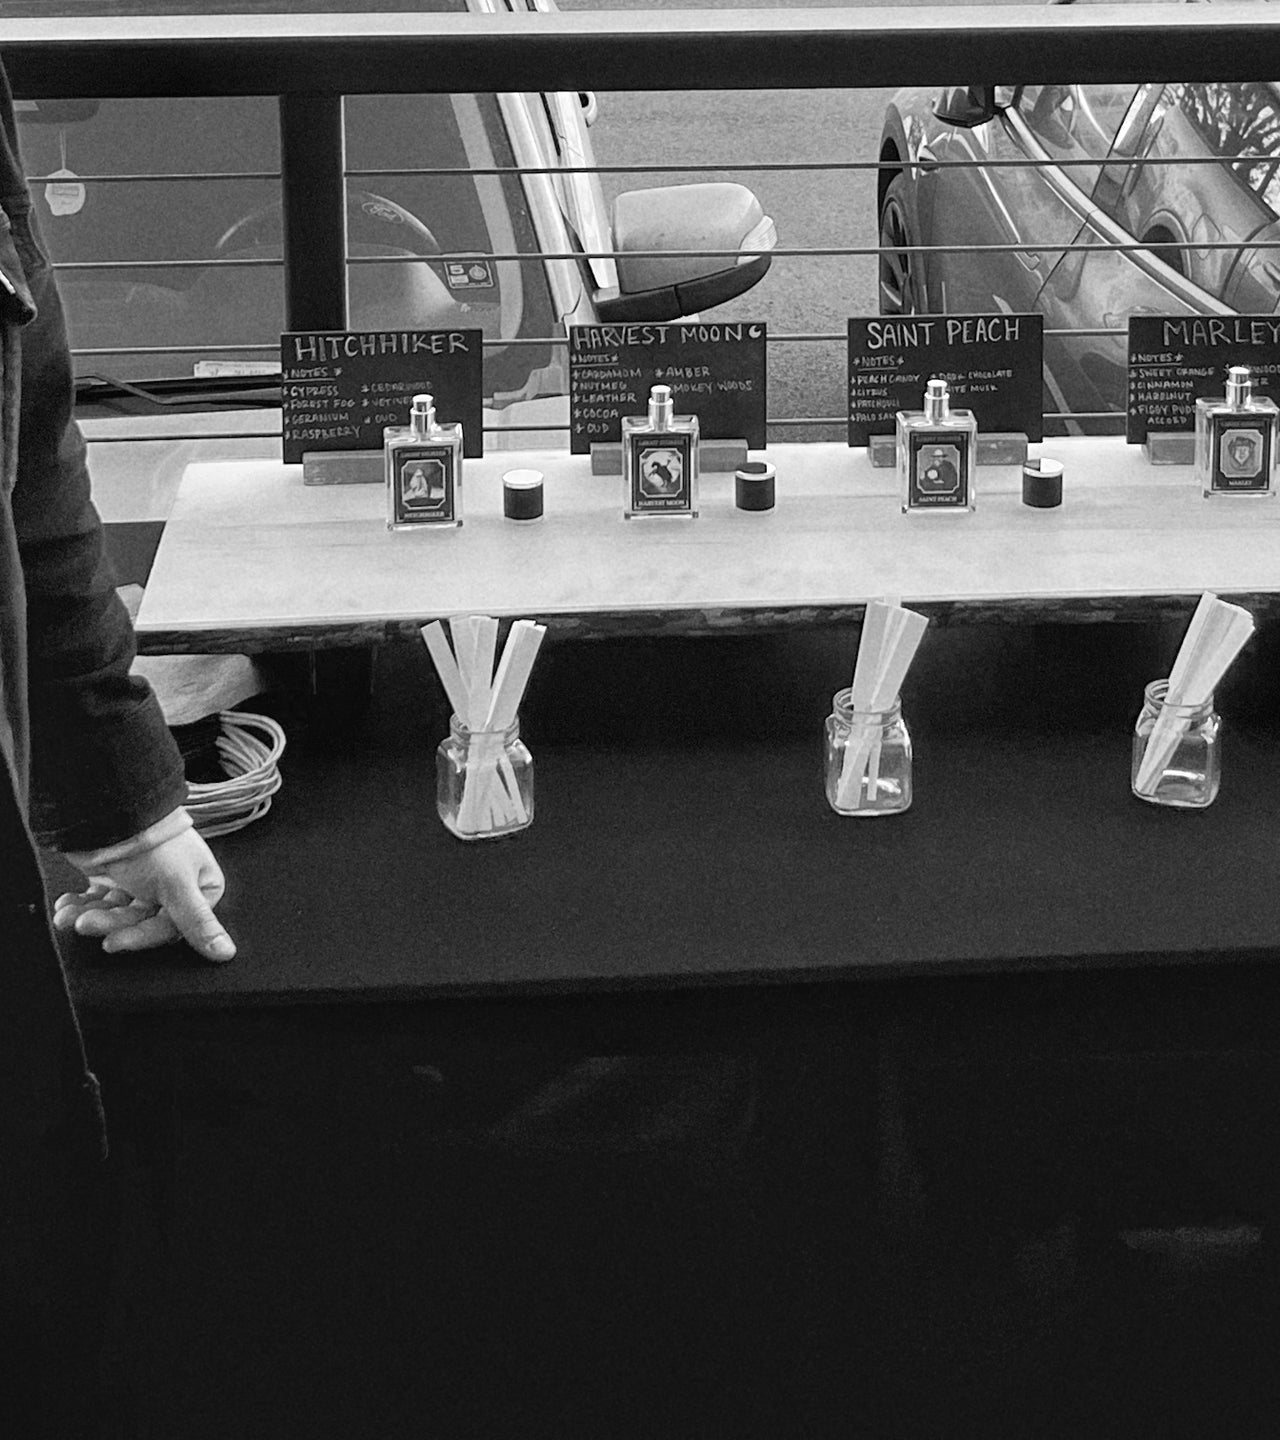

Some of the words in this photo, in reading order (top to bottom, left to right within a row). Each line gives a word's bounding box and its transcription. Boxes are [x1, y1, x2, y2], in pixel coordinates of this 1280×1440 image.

[573, 325, 670, 351] HARVEST
[680, 323, 742, 344] MOON
[867, 321, 935, 350] SAINT
[946, 318, 1020, 345] PEACH
[295, 333, 469, 362] HITCHHIKER
[578, 354, 610, 363] NOTES
[861, 356, 895, 367] NOTES
[1137, 352, 1173, 363] NOTES
[290, 367, 329, 378] NOTES
[581, 367, 642, 380] CARDAMOM
[665, 366, 710, 378] AMBER
[968, 369, 1013, 380] CHOCOLATE
[1139, 368, 1172, 379] SWEET
[1176, 366, 1215, 377] ORANGE
[857, 374, 888, 385] PEACH
[888, 374, 920, 383] CANDY
[1137, 380, 1194, 390] CINNAMON
[290, 385, 340, 397] CYPRESS
[580, 381, 628, 392] NUTMEG
[716, 380, 753, 392] WOODS
[970, 383, 999, 393] MUSK
[582, 392, 638, 403] LEATHER
[857, 387, 888, 397] CITRUS
[1138, 391, 1192, 402] HAZELNUT
[290, 399, 330, 410] FOREST
[333, 398, 356, 408] FOG
[372, 396, 413, 407] VETIVE
[582, 408, 620, 420] COCOA
[1137, 404, 1169, 415] FIGGY
[292, 412, 350, 425] GERANIUM
[374, 413, 399, 424] OUD
[856, 412, 877, 423] PALO
[1147, 416, 1188, 426] ACCORD
[292, 425, 361, 440] RASPBERRY
[587, 422, 610, 434] OUD
